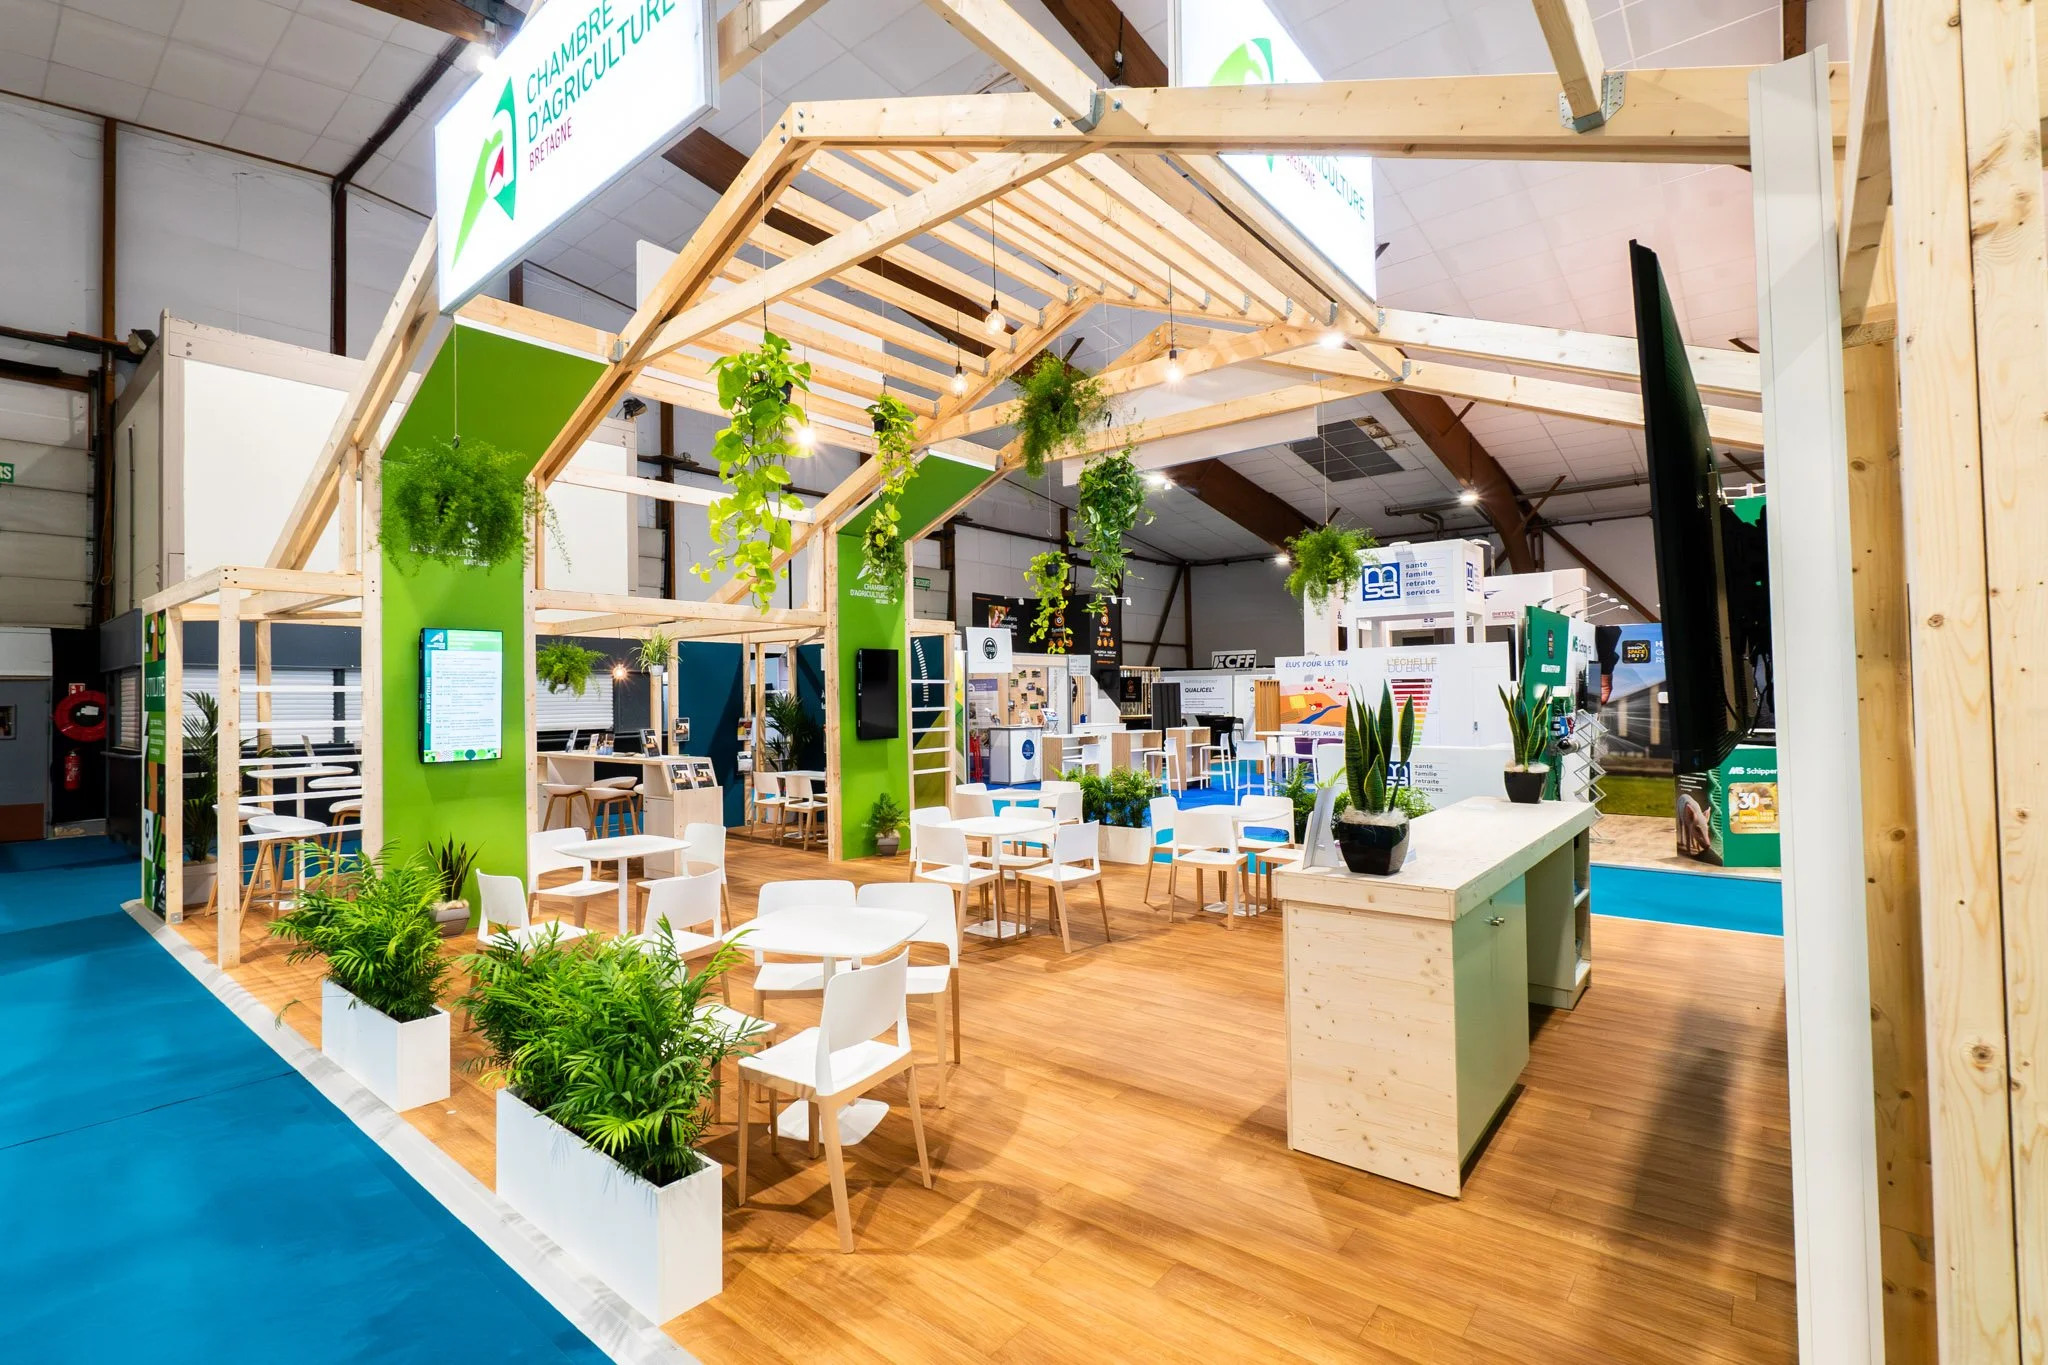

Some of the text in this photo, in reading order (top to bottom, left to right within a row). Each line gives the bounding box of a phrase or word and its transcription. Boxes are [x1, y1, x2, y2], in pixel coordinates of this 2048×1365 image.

[527, 0, 614, 104] CHAMBRE
[529, 117, 573, 172] BRETAGNE
[1405, 562, 1428, 570] santé
[1405, 579, 1436, 587] retraite
[1406, 588, 1440, 596] services
[1738, 793, 1760, 809] 30
